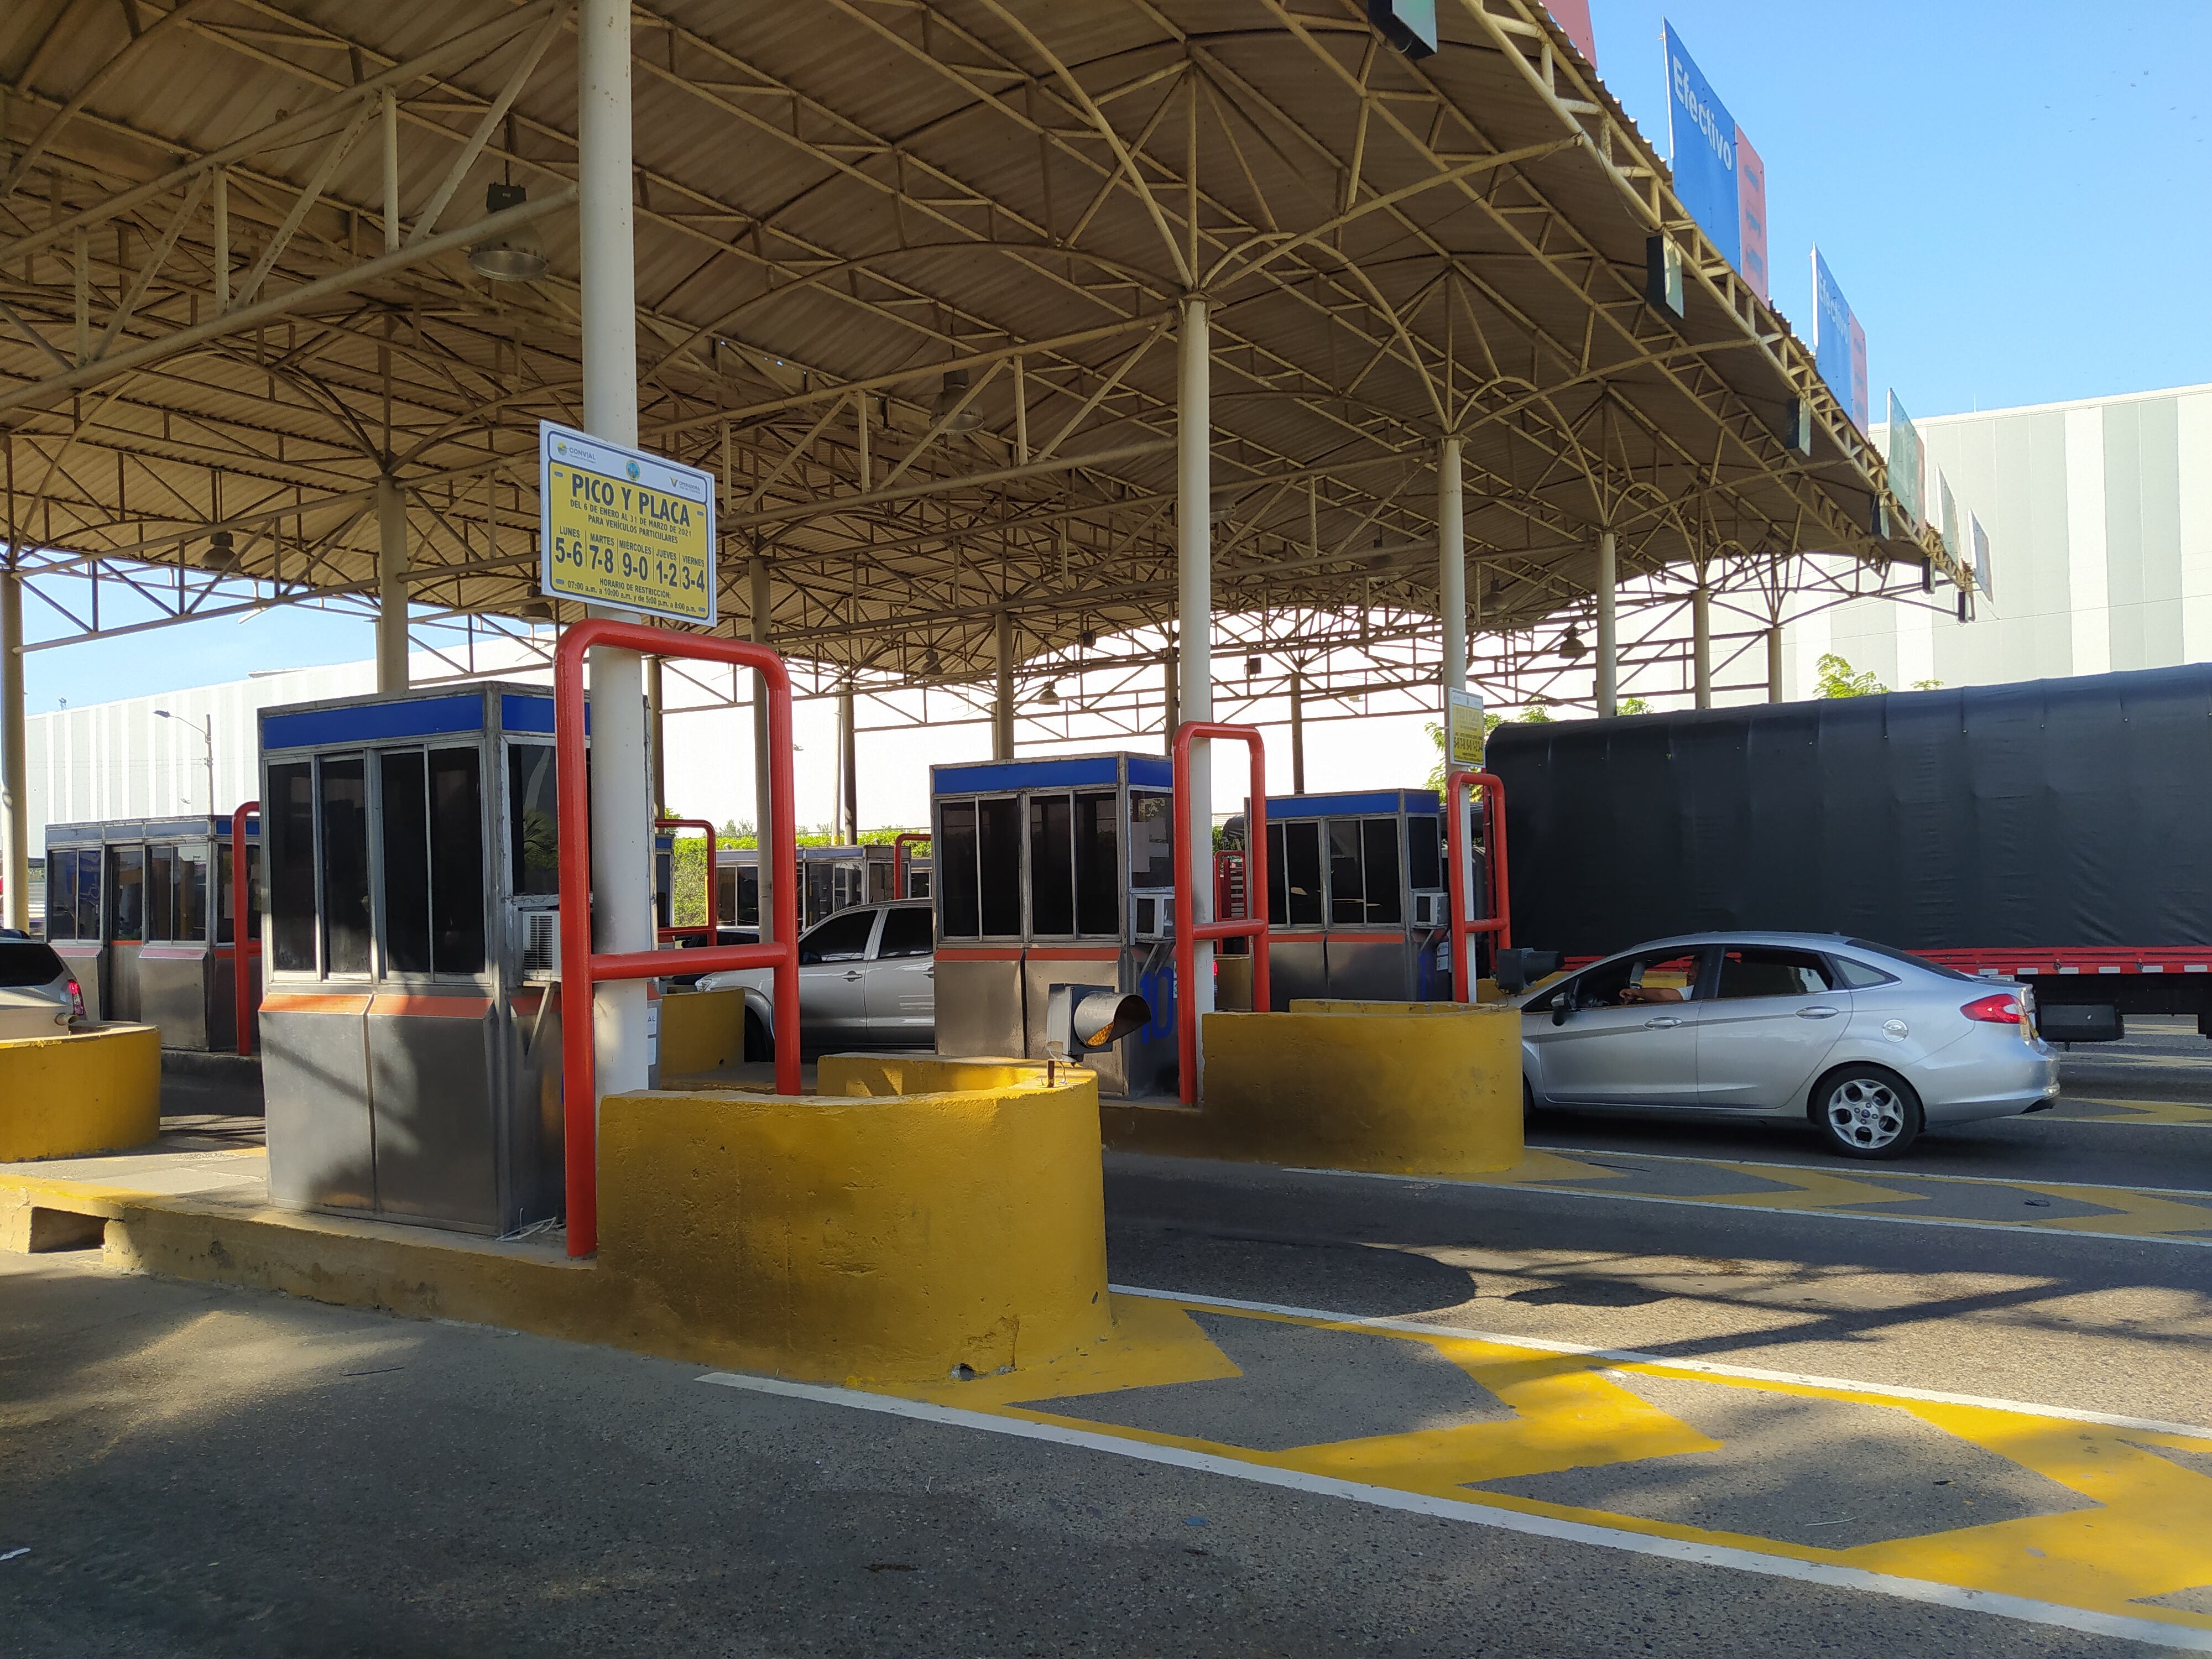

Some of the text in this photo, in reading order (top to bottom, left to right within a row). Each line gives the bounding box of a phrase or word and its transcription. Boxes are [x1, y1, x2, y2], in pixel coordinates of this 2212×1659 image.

[1673, 55, 1733, 170] Efectivo
[569, 447, 596, 460] CONVIAL
[570, 499, 691, 538] DEL 6 DE ENERO AL 31 DE MARZO DE 2021
[572, 473, 691, 528] PICO Y PLACA
[560, 525, 705, 568] LUNES MARTES MIÉRCOLES JUEVES VIERNES
[588, 514, 678, 544] PARA VEHÍCULOS PARTICULARES
[555, 536, 705, 593] 5-6 7-8 9-0 1-2 3-4
[599, 578, 625, 589] HORARIO
[626, 583, 634, 592] DE
[567, 580, 584, 591] 07:00
[604, 587, 619, 597] 10:00
[645, 596, 657, 605] 5:00
[674, 601, 685, 610] 8:00
[1140, 967, 1174, 1045] 10
